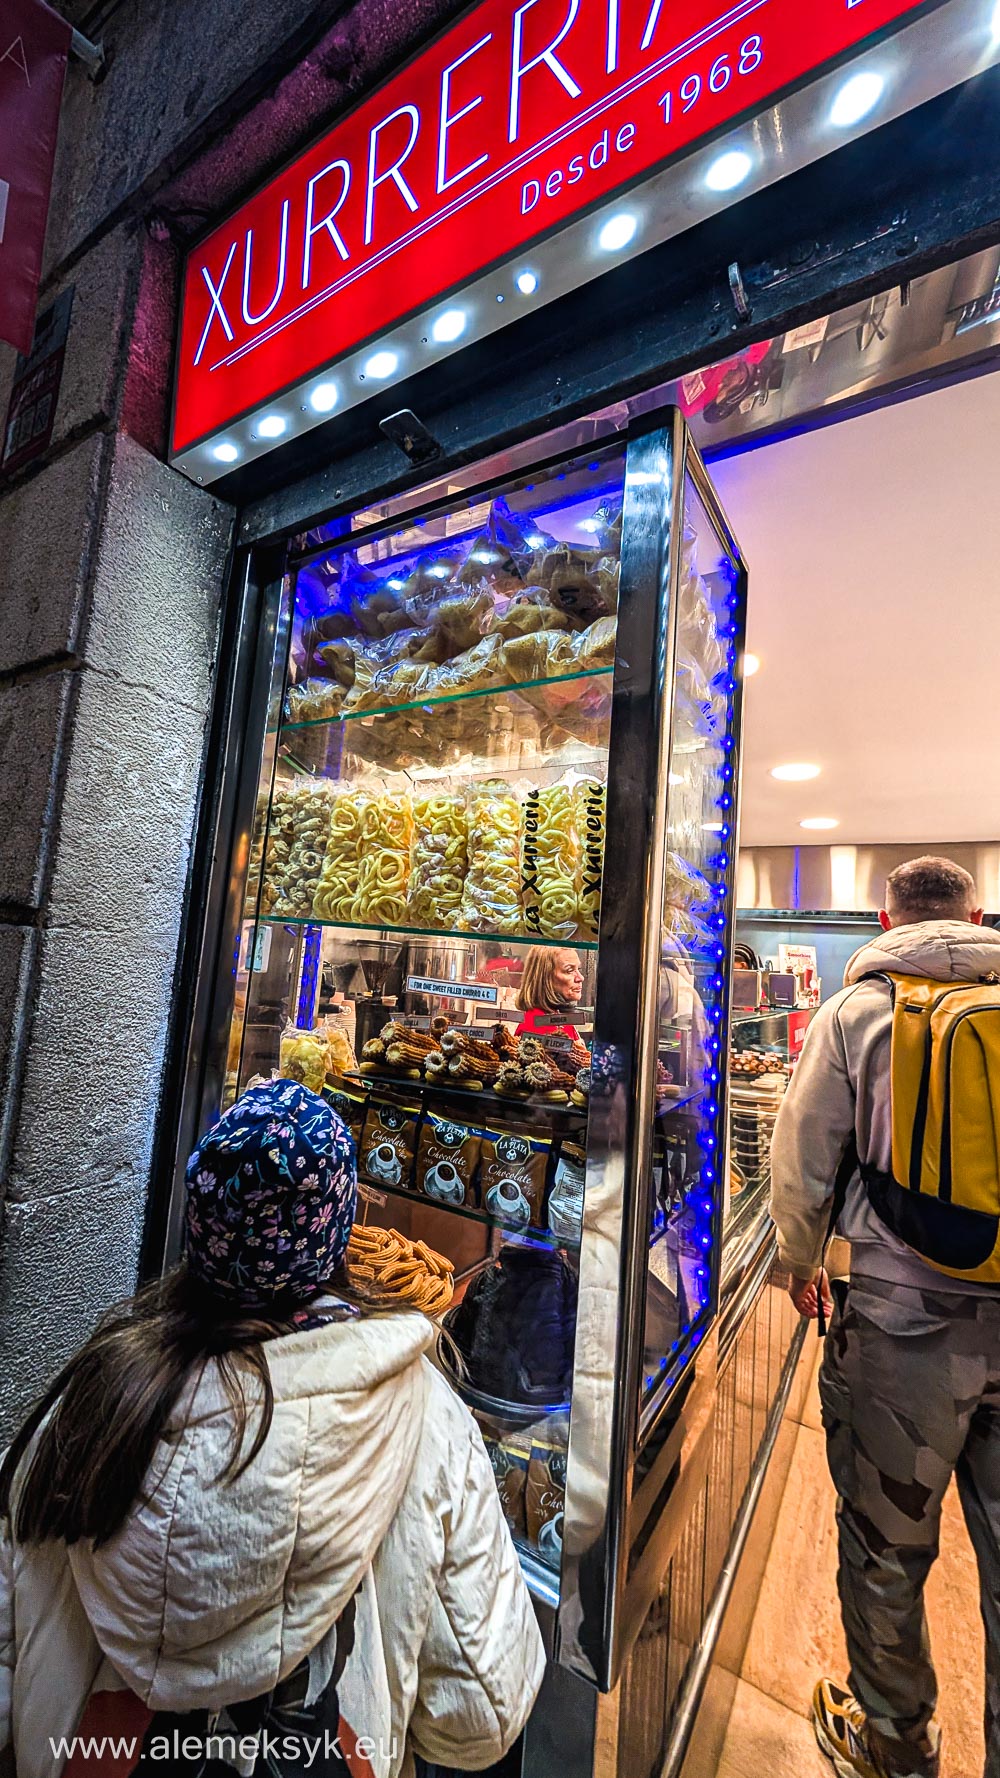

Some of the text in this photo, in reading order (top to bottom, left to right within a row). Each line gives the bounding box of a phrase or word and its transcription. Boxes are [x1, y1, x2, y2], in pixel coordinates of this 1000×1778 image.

[521, 34, 763, 215] Desde 1968
[413, 981, 422, 989] FOR
[423, 983, 432, 991] ONE
[433, 984, 447, 992] SWEET
[447, 986, 461, 995] FILLED
[462, 988, 480, 997] CHURRO
[427, 1146, 467, 1166] Chocolate
[499, 1141, 527, 1155] LA PLATA
[488, 1163, 532, 1184] Chocolate
